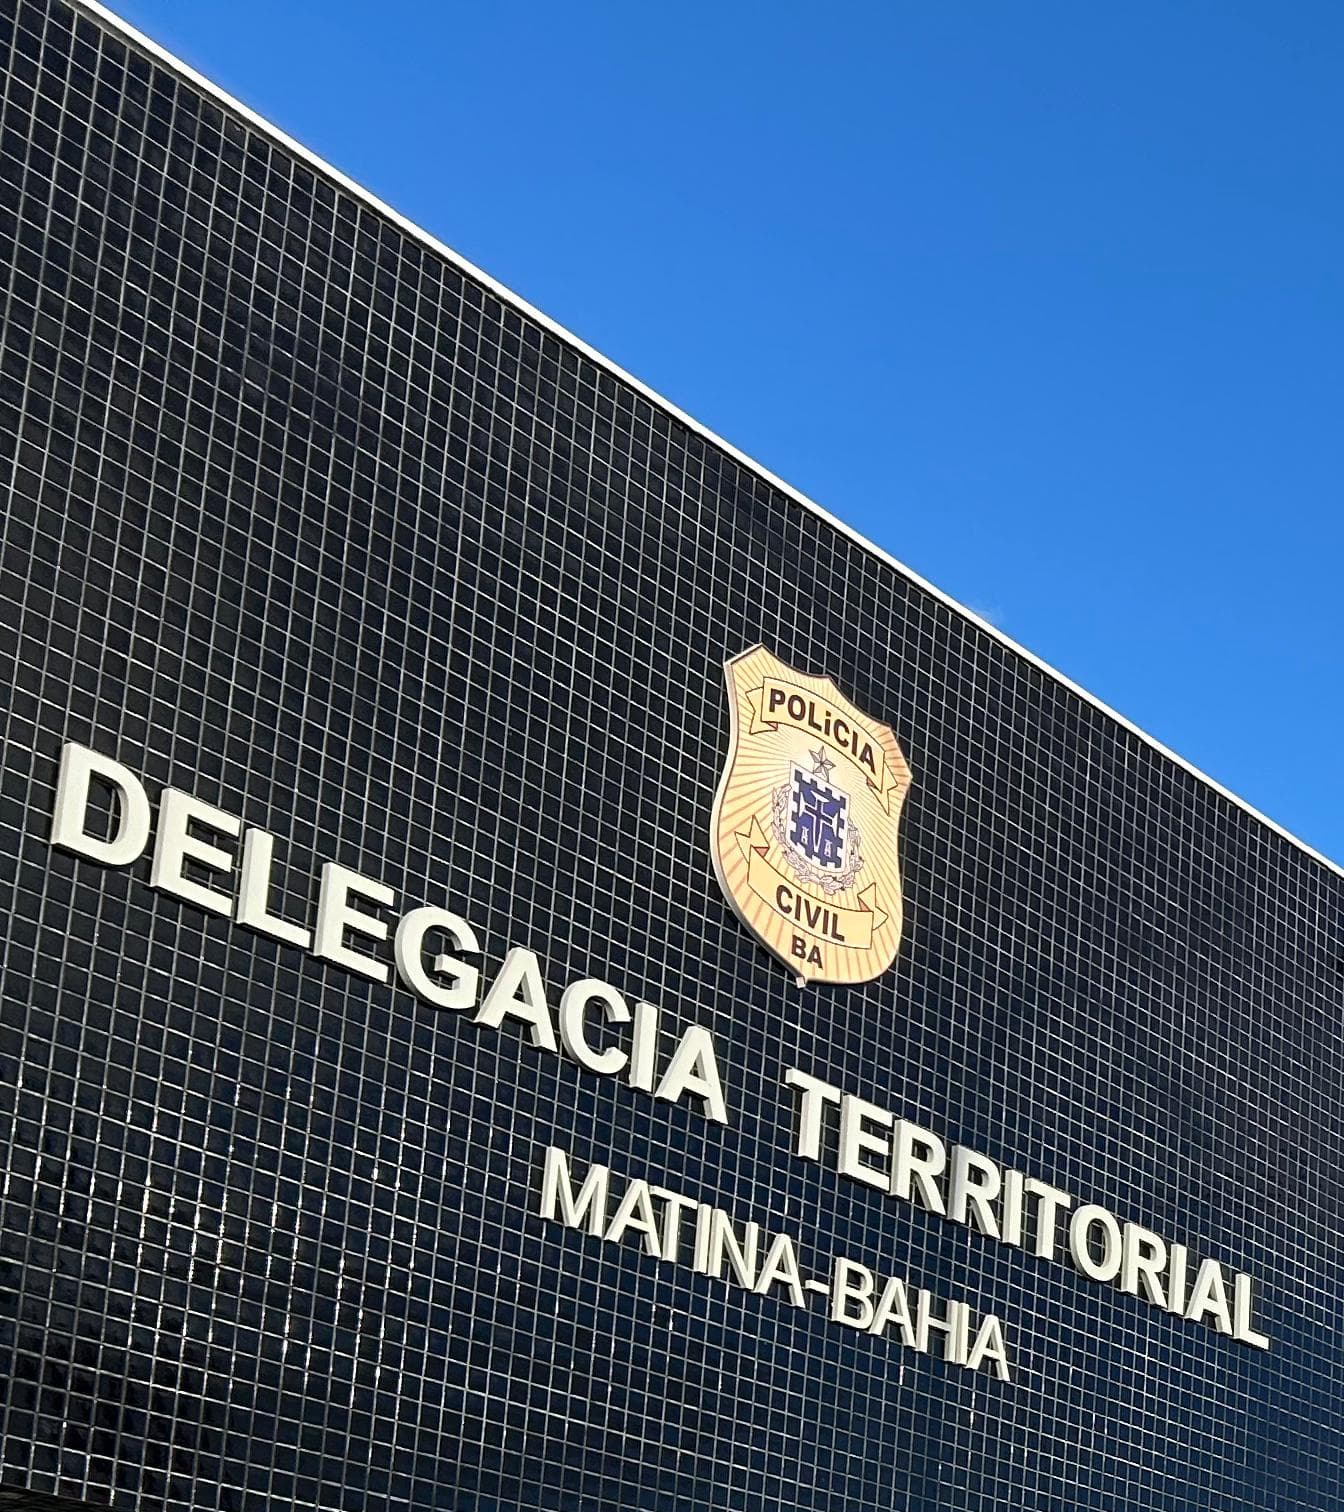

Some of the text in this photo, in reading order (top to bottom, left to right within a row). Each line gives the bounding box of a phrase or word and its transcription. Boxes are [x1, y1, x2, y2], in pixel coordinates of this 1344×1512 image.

[776, 884, 845, 942] CIVIL
[790, 935, 824, 970] BA
[49, 741, 1270, 1350] DELEGACIA TERRITORIAL
[540, 1145, 1011, 1382] MATINA-BAHIA
